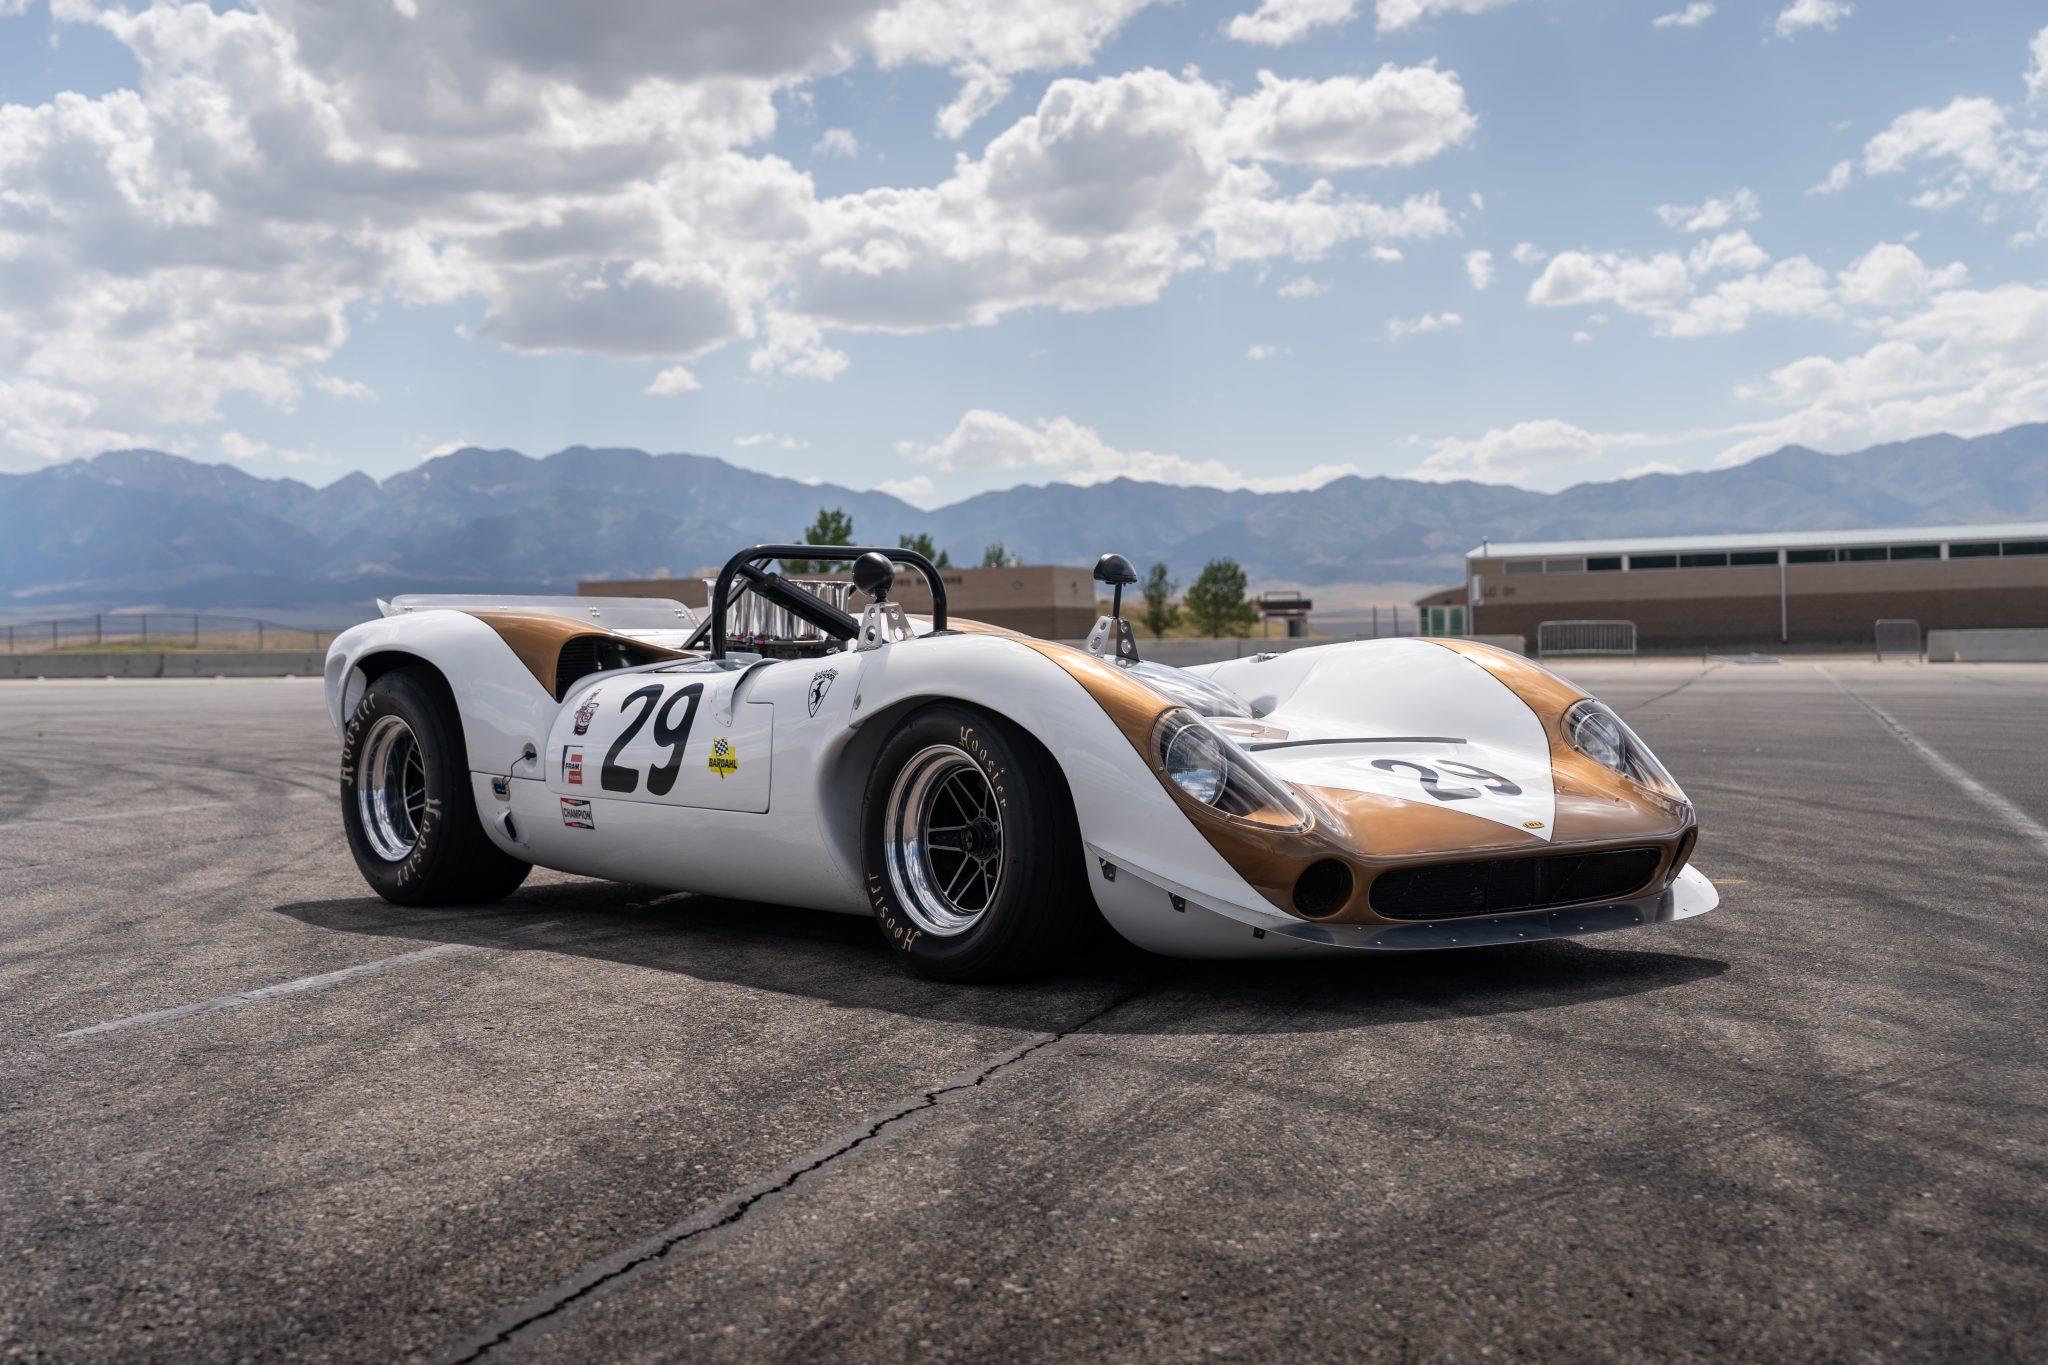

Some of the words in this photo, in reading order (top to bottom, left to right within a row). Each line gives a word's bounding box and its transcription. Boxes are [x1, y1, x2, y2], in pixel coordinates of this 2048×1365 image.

[601, 682, 704, 796] 29
[708, 757, 738, 770] BARDAHL
[958, 726, 1008, 808] Hoosier
[1370, 759, 1522, 801] 29
[564, 807, 592, 820] CHAMPION
[868, 872, 922, 953] Hoosier
